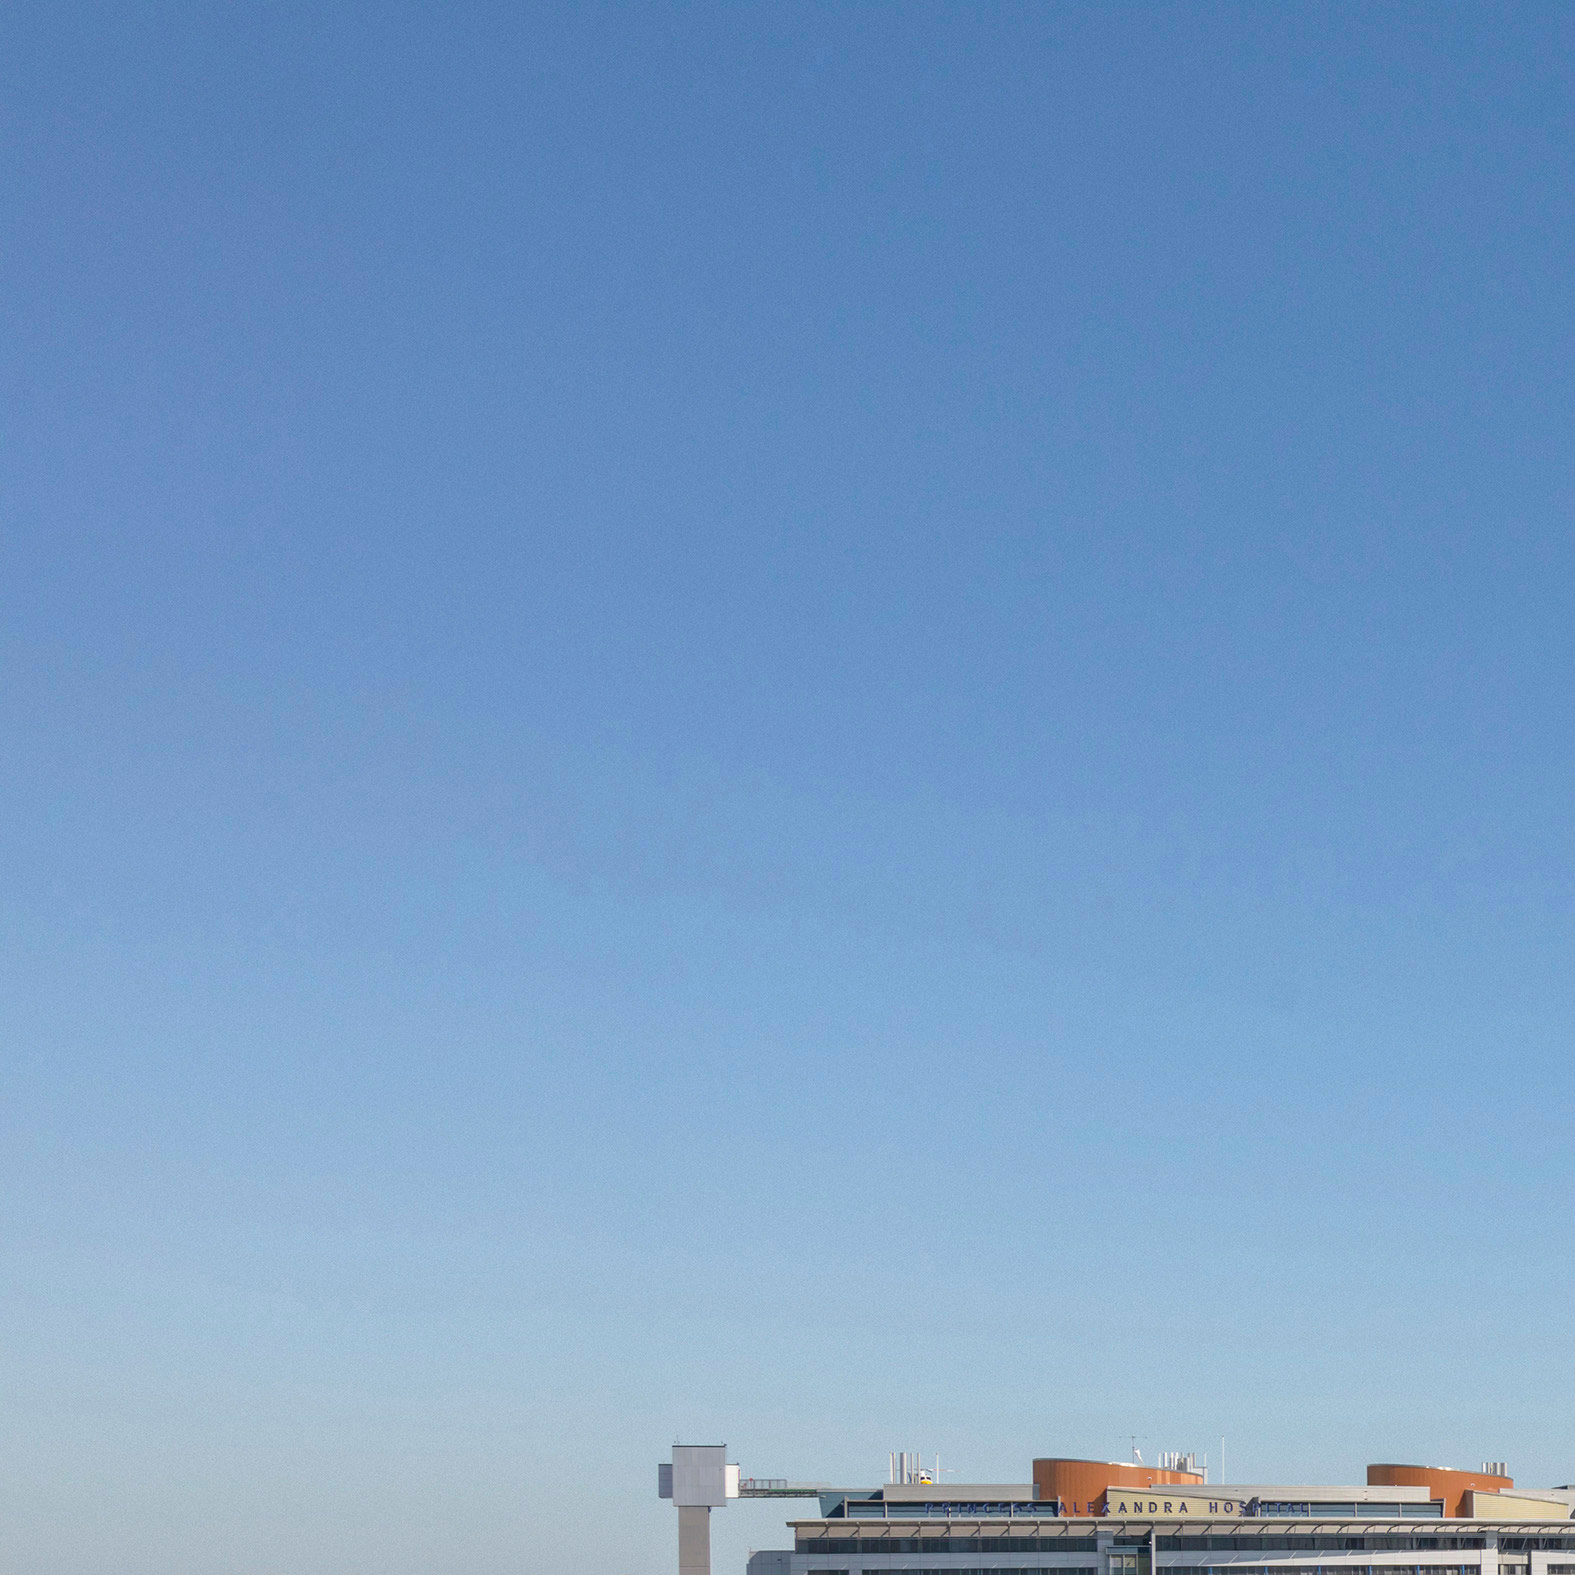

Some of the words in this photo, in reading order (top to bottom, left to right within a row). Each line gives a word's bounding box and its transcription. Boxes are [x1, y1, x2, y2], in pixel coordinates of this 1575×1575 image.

[925, 1502, 1037, 1514] PRINCESS
[1057, 1502, 1188, 1514] ALEXANDRA
[1209, 1502, 1309, 1514] HOSPITAL
